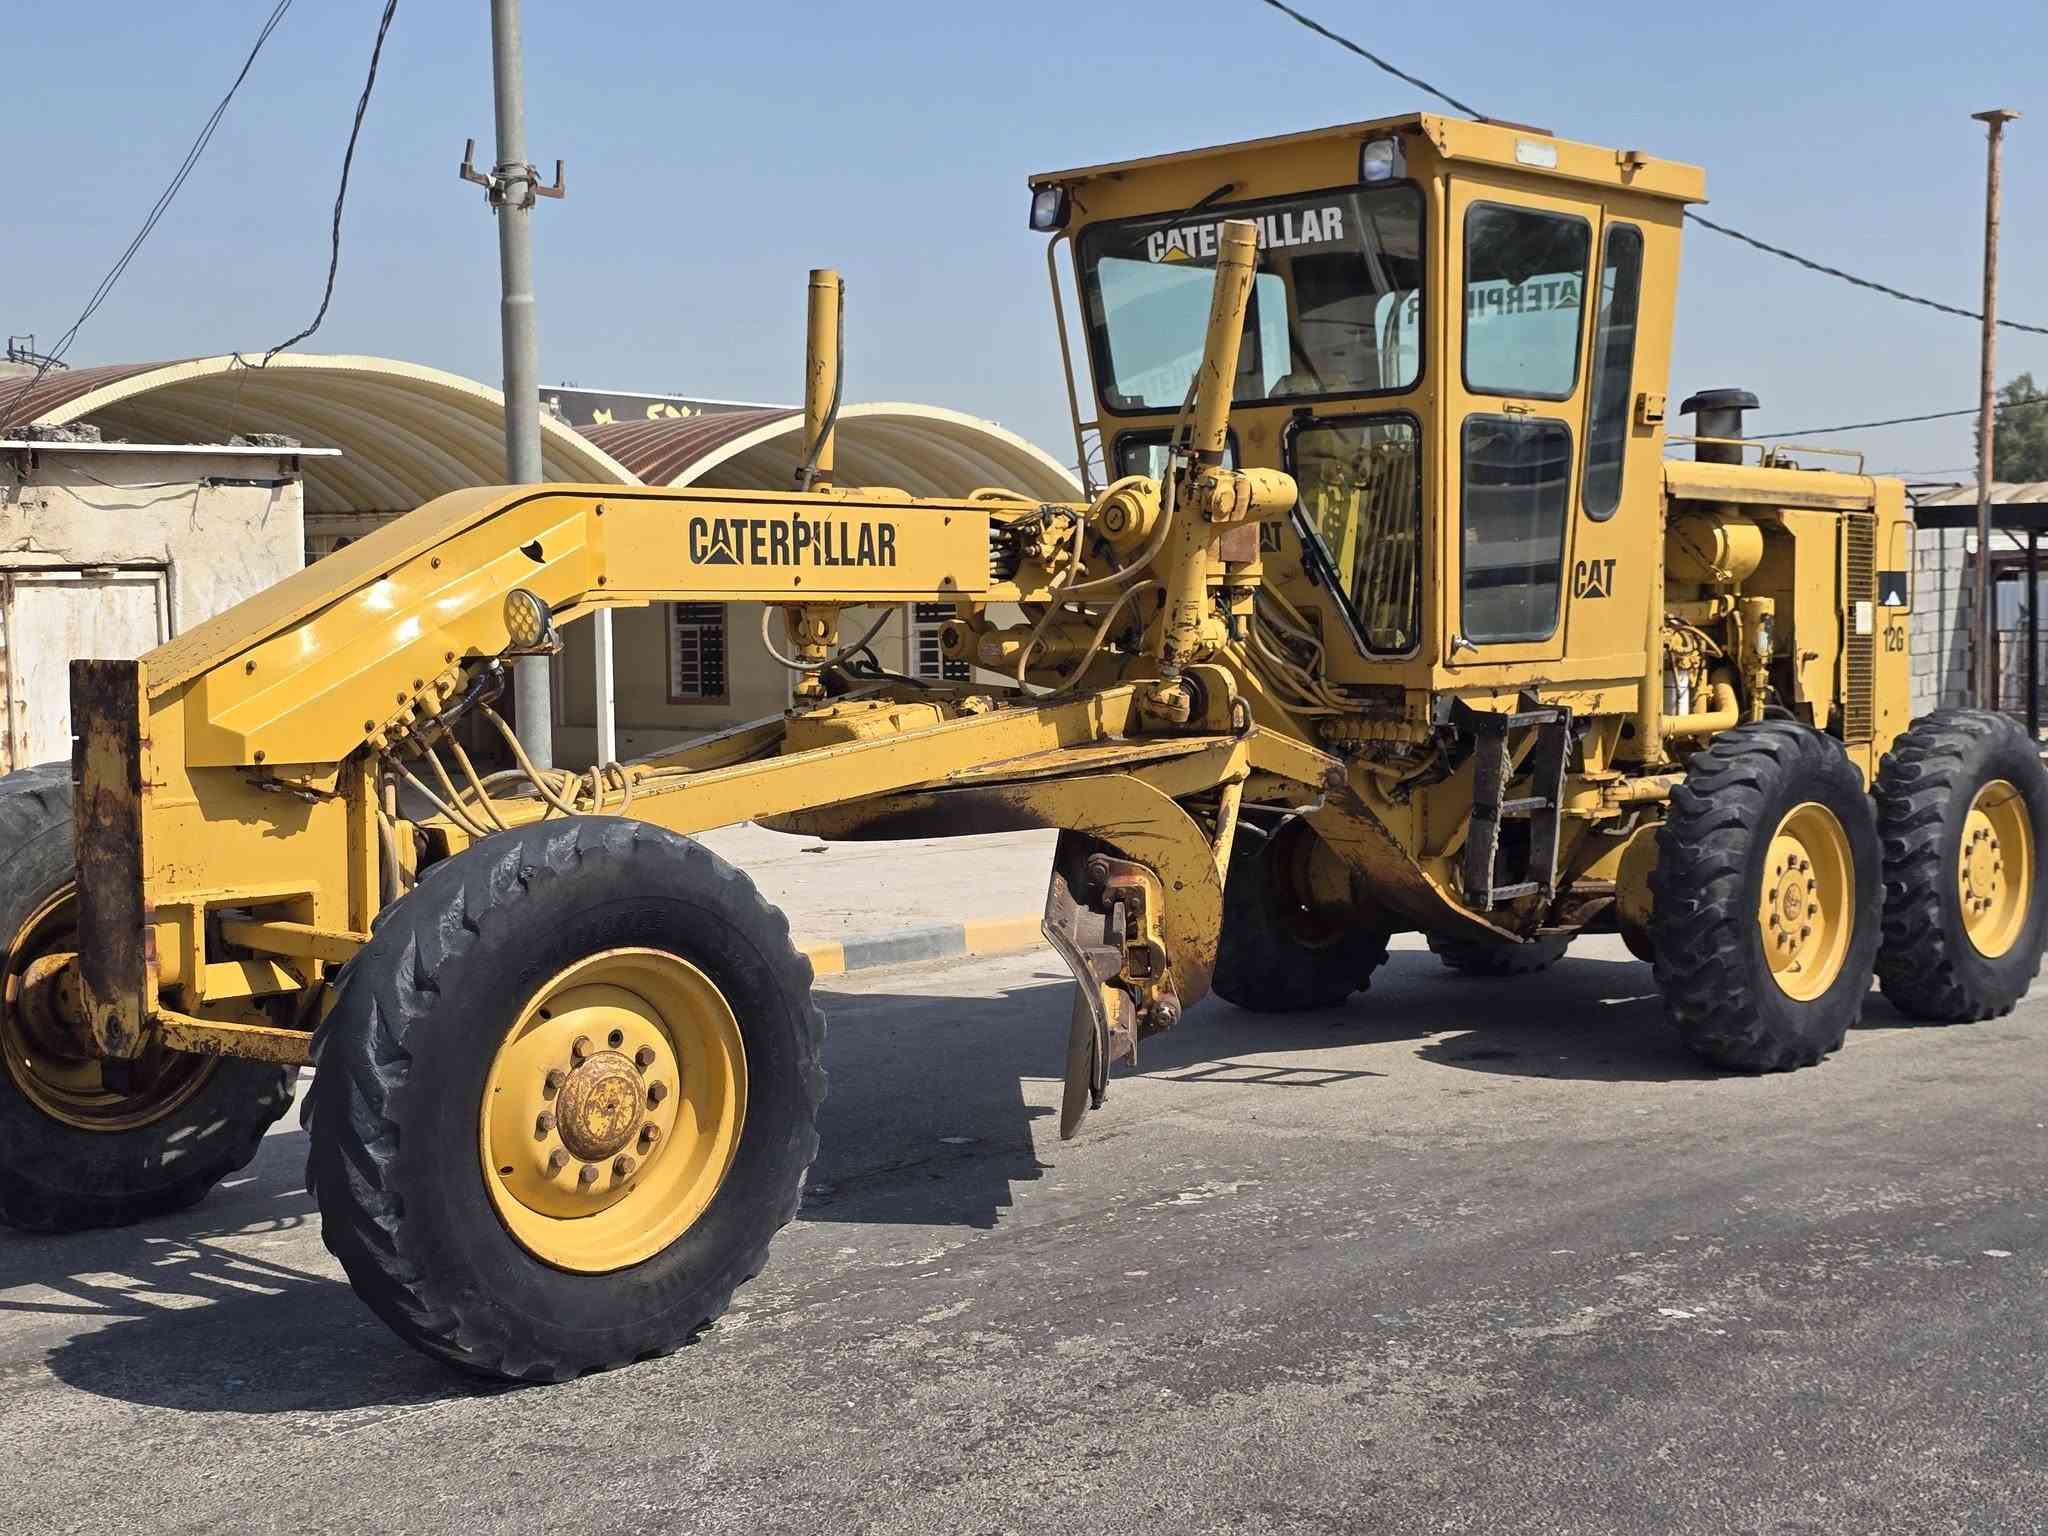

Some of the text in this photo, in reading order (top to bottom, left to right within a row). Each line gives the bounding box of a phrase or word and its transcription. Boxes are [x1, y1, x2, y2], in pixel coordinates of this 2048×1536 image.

[1147, 206, 1344, 263] CATEILLAR
[689, 516, 897, 567] CATERPILLAR
[1260, 521, 1282, 553] AT
[1574, 558, 1617, 599] CAT
[1883, 626, 1905, 653] 12G
